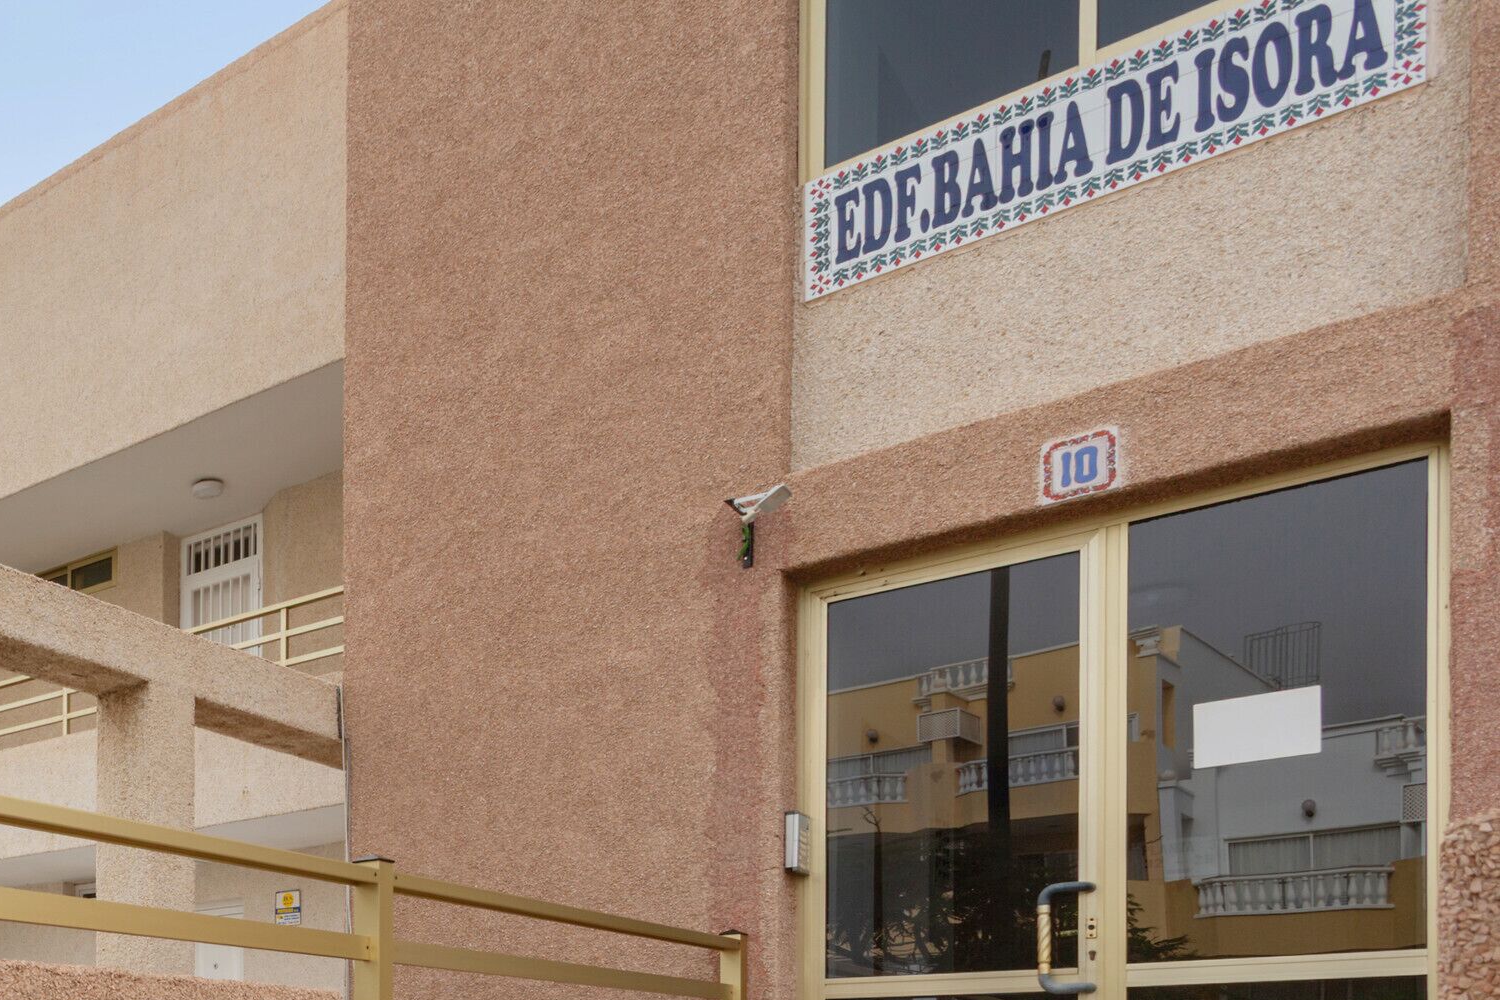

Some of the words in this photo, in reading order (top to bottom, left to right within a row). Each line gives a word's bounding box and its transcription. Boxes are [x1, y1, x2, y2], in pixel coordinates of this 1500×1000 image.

[1106, 60, 1182, 163] DE
[1194, 0, 1389, 133] ISORA
[1061, 446, 1098, 487] 10
